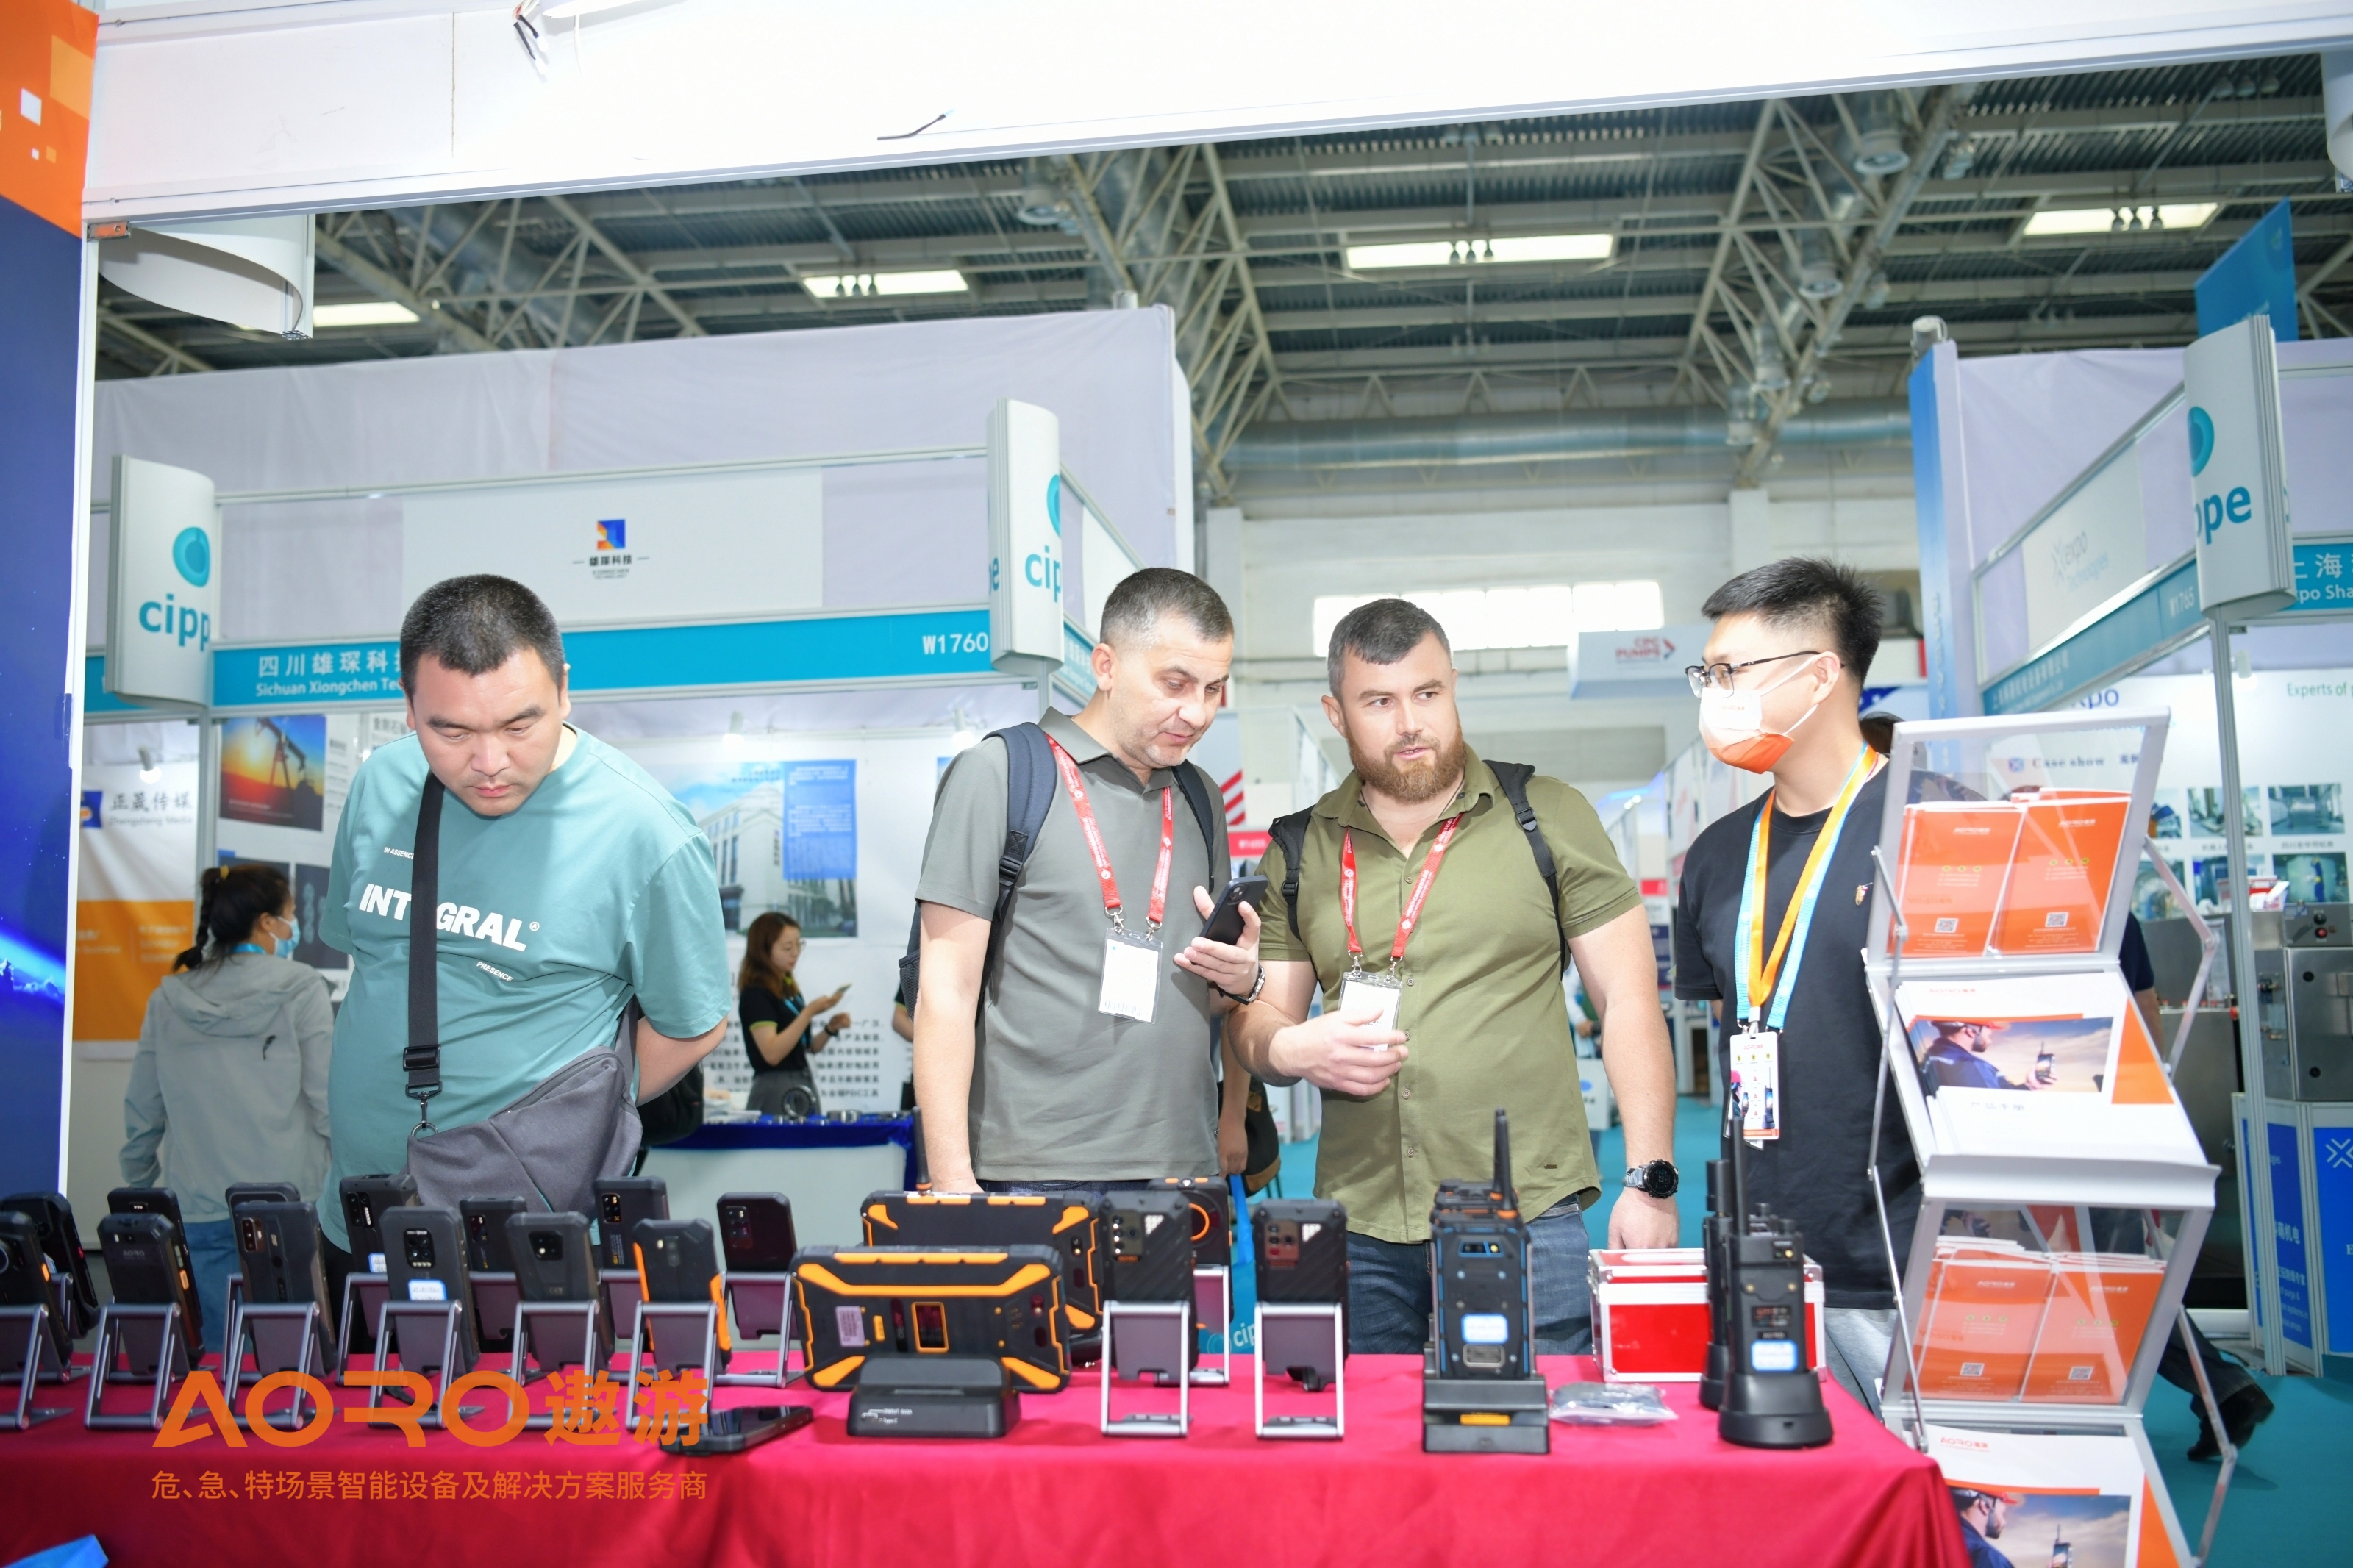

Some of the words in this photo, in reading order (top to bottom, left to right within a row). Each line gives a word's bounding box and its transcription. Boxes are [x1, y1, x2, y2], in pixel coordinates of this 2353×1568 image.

[2196, 486, 2252, 544] pe
[923, 632, 988, 656] W1760
[256, 683, 306, 697] Sichuan
[309, 679, 377, 695] Xiongchen
[359, 883, 526, 952] INTGRAL
[476, 961, 513, 982] PRESENCE
